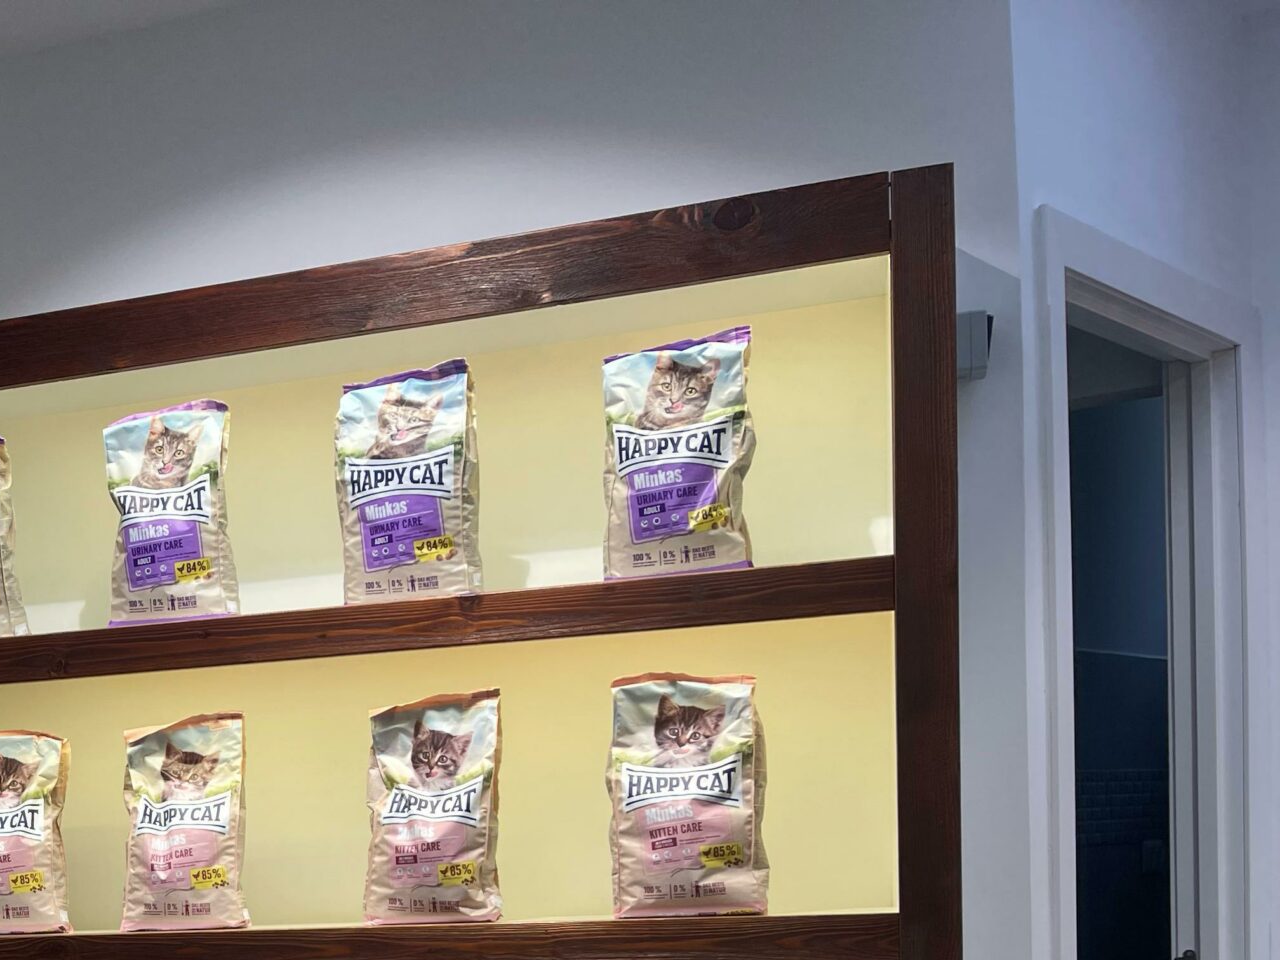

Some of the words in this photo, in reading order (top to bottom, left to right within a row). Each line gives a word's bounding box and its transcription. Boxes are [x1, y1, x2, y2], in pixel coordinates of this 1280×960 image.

[618, 436, 682, 464] HAPPY
[686, 428, 726, 456] CAT
[350, 466, 407, 496] HAPPY
[409, 460, 448, 486] CAT
[634, 469, 682, 490] Minkas
[118, 495, 171, 515] HAPPY
[173, 486, 206, 511] CAT
[637, 490, 674, 505] URINARY
[676, 486, 698, 498] CARE
[364, 500, 408, 521] Minkas
[128, 524, 170, 542] Minkas
[370, 522, 400, 536] URINARY
[402, 516, 424, 529] CARE
[131, 542, 162, 556] URINARY
[164, 539, 184, 551] CARE
[426, 538, 448, 552] 84%
[186, 561, 206, 574] 84%
[628, 774, 694, 798] HAPPY
[696, 768, 736, 794] CAT
[389, 790, 441, 814] HAPPY
[442, 788, 476, 813] CAT
[10, 810, 38, 830] CAT
[140, 804, 188, 826] HAPPY
[190, 802, 225, 822] CAT
[649, 826, 678, 839] KITTEN
[680, 822, 704, 834] CARE
[174, 848, 193, 858] CARE
[420, 842, 441, 852] CARE
[713, 845, 736, 857] 85%
[20, 874, 38, 884] 85%
[202, 868, 222, 880] 85%
[451, 864, 472, 876] 85%
